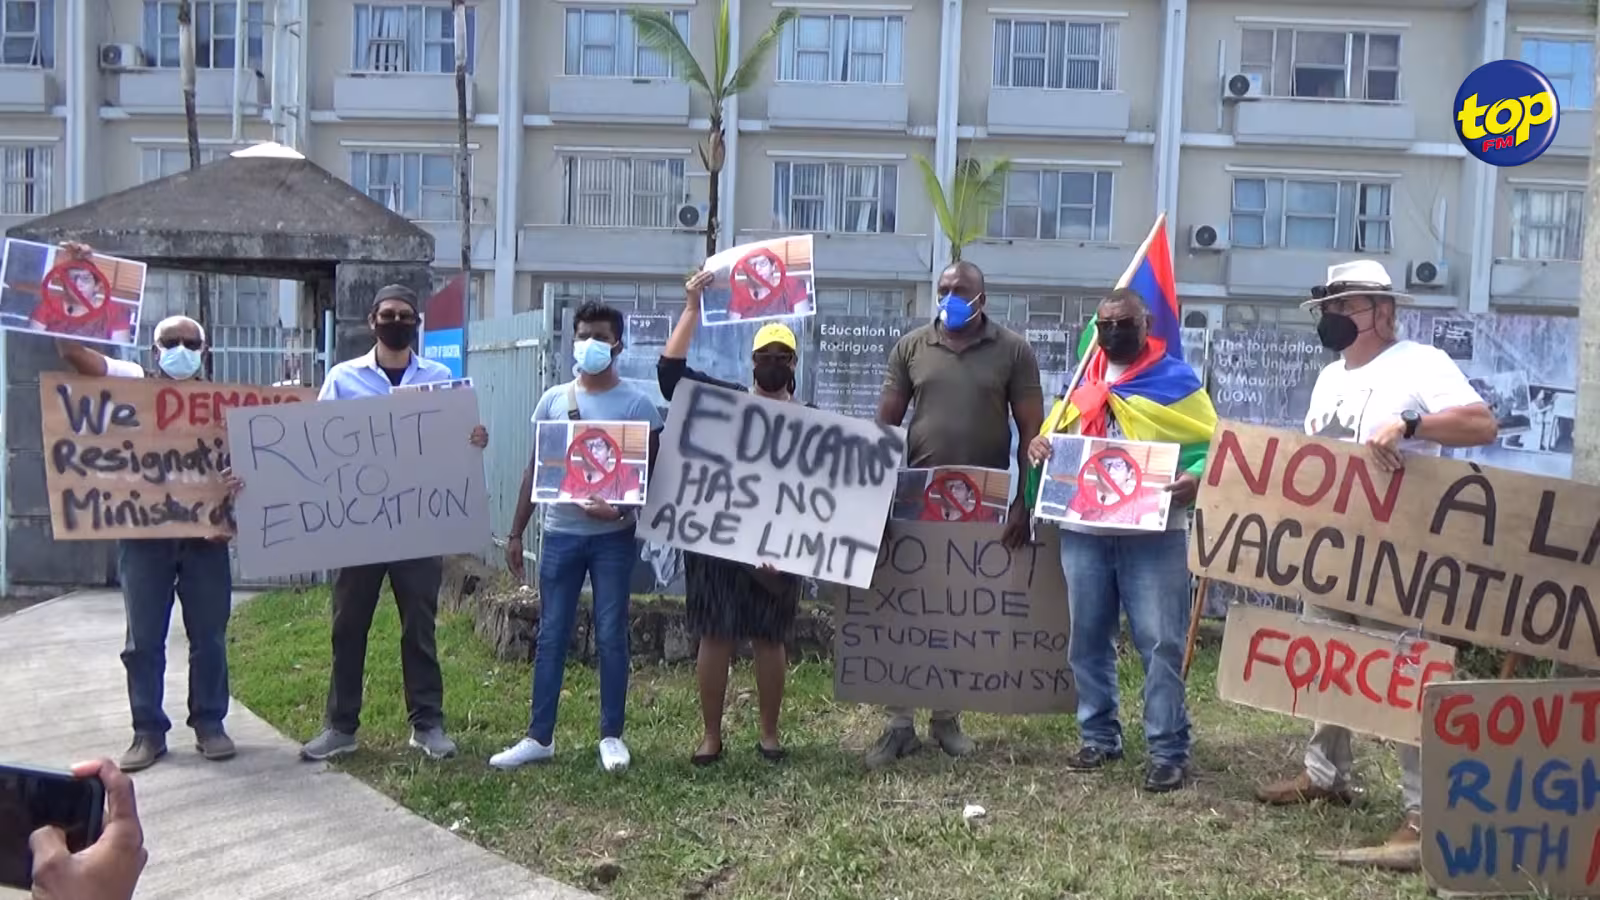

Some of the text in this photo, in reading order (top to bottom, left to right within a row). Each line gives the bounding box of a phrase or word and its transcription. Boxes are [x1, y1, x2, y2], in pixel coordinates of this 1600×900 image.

[820, 324, 885, 337] Education
[820, 341, 884, 355] Rodrigues
[1247, 339, 1323, 354] foundation
[56, 384, 302, 435] We DEMA
[1217, 389, 1262, 405] (UOM)
[249, 409, 442, 486] RIGHT
[678, 385, 904, 488] EDUCATION
[323, 462, 390, 496] TO
[675, 461, 836, 523] HAS NO
[1207, 429, 1405, 523] NON
[1429, 462, 1497, 546] À
[261, 477, 470, 548] EDUCATION
[651, 502, 879, 580] AGE LIMIT
[946, 536, 1047, 589] NOT
[845, 585, 1031, 618] EXCLUDE
[1196, 508, 1600, 654] VACCINATION
[842, 622, 1002, 650] STUDENT
[840, 656, 1024, 691] EDUCATION
[1434, 821, 1570, 880] WITH
